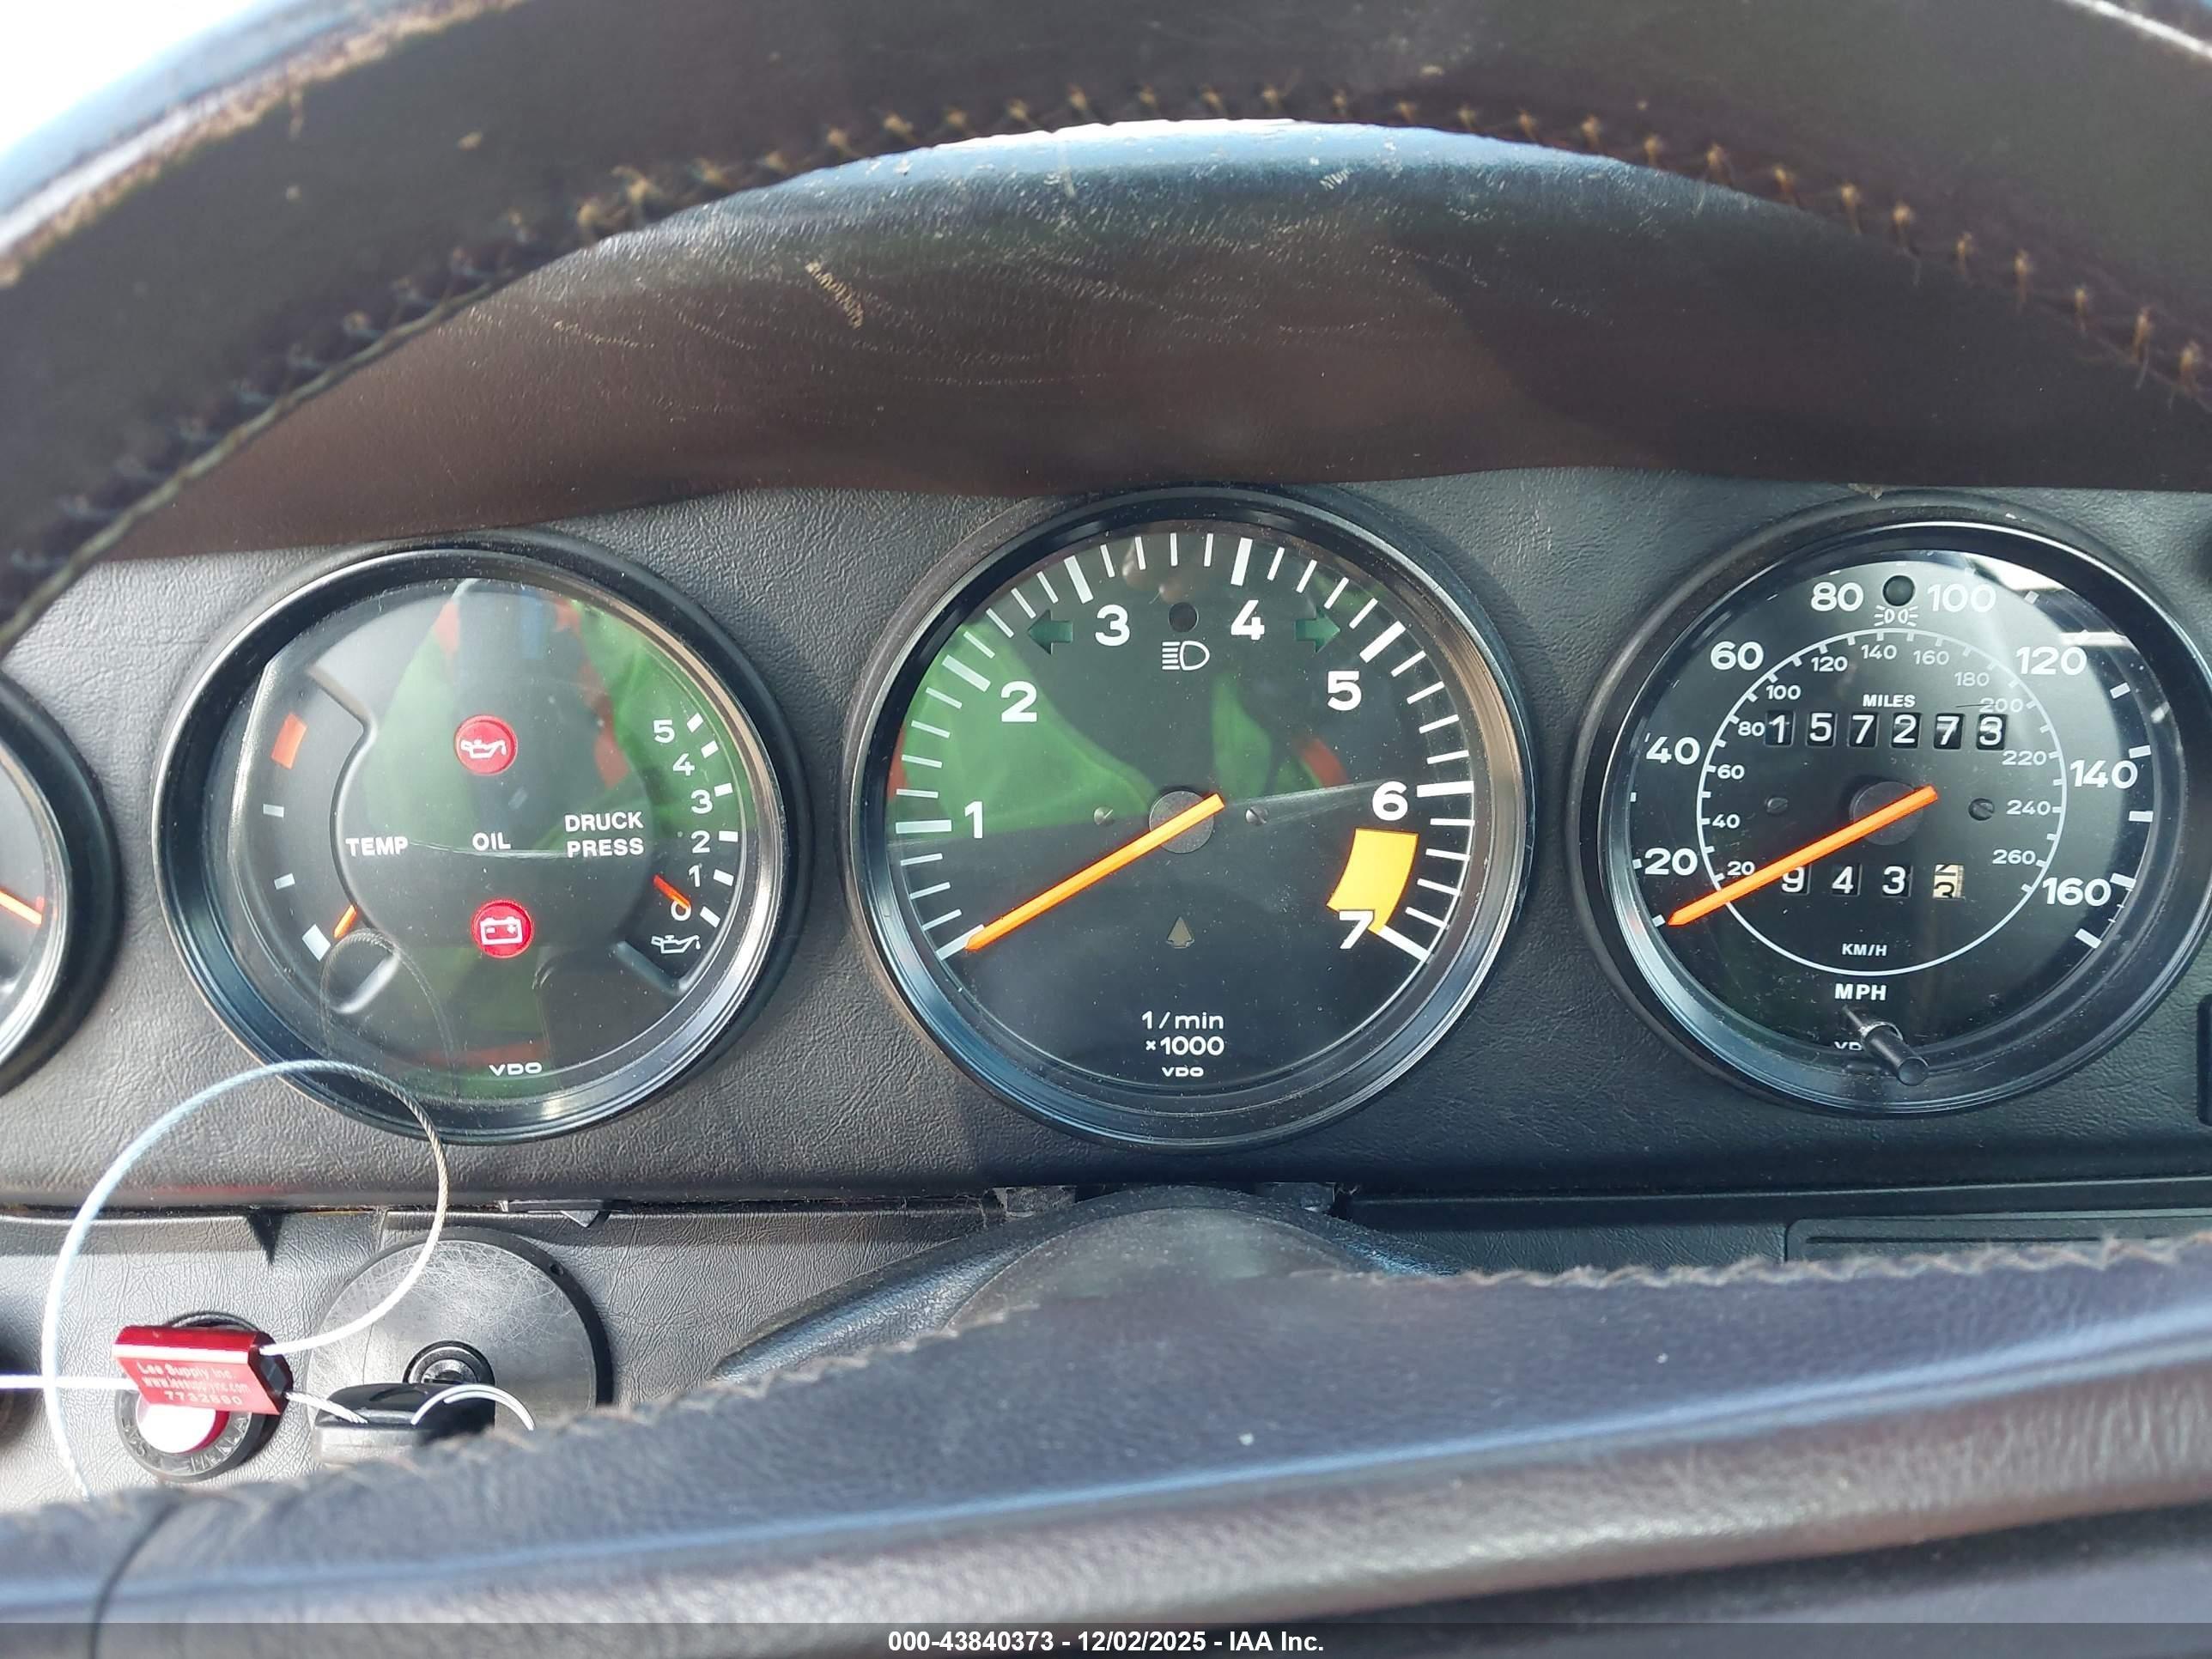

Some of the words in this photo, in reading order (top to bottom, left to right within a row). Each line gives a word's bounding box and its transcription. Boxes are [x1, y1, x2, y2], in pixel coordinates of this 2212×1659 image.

[1811, 582, 1864, 611] 80
[1927, 583, 1997, 612] 100
[1095, 605, 1130, 646] 3
[1231, 600, 1266, 640] 4
[1711, 641, 1764, 670] 60
[1861, 644, 1897, 659] 140
[1913, 649, 1950, 665] 160
[2015, 646, 2087, 676] 120
[1810, 655, 1848, 672] 120
[1954, 672, 1990, 687] 180
[1000, 682, 1037, 722] 2
[1328, 671, 1362, 711] 5
[1765, 684, 1802, 701] 100
[1862, 694, 1917, 708] MILES
[1979, 697, 2024, 714] 200
[653, 720, 675, 744] 5
[1738, 720, 1765, 737] 80
[1645, 736, 1701, 765] 40
[2002, 750, 2047, 766] 220
[672, 753, 695, 776] 4
[1717, 763, 1745, 780] 60
[2069, 759, 2138, 789] 140
[690, 789, 714, 814] 3
[1373, 781, 1408, 821] 6
[2006, 799, 2051, 816] 240
[564, 811, 644, 833] DRUCK
[964, 800, 984, 839] 1
[1711, 813, 1741, 830] 40
[344, 836, 409, 857] TEMP
[471, 831, 512, 852] OIL
[566, 836, 645, 859] PRESS
[690, 830, 711, 854] 2
[1644, 847, 1698, 876] 20
[1991, 848, 2036, 866] 260
[688, 864, 702, 888] 1
[1726, 860, 1756, 877] 20
[2042, 877, 2112, 907] 160
[670, 899, 692, 921] 0
[1338, 911, 1376, 950] 7
[1841, 943, 1888, 957] KM/H
[1834, 983, 1887, 1001] MPH
[1834, 1041, 1863, 1051] VD
[488, 1061, 543, 1077] VDO
[1161, 1066, 1205, 1078] VDO
[165, 1362, 210, 1381] Supply
